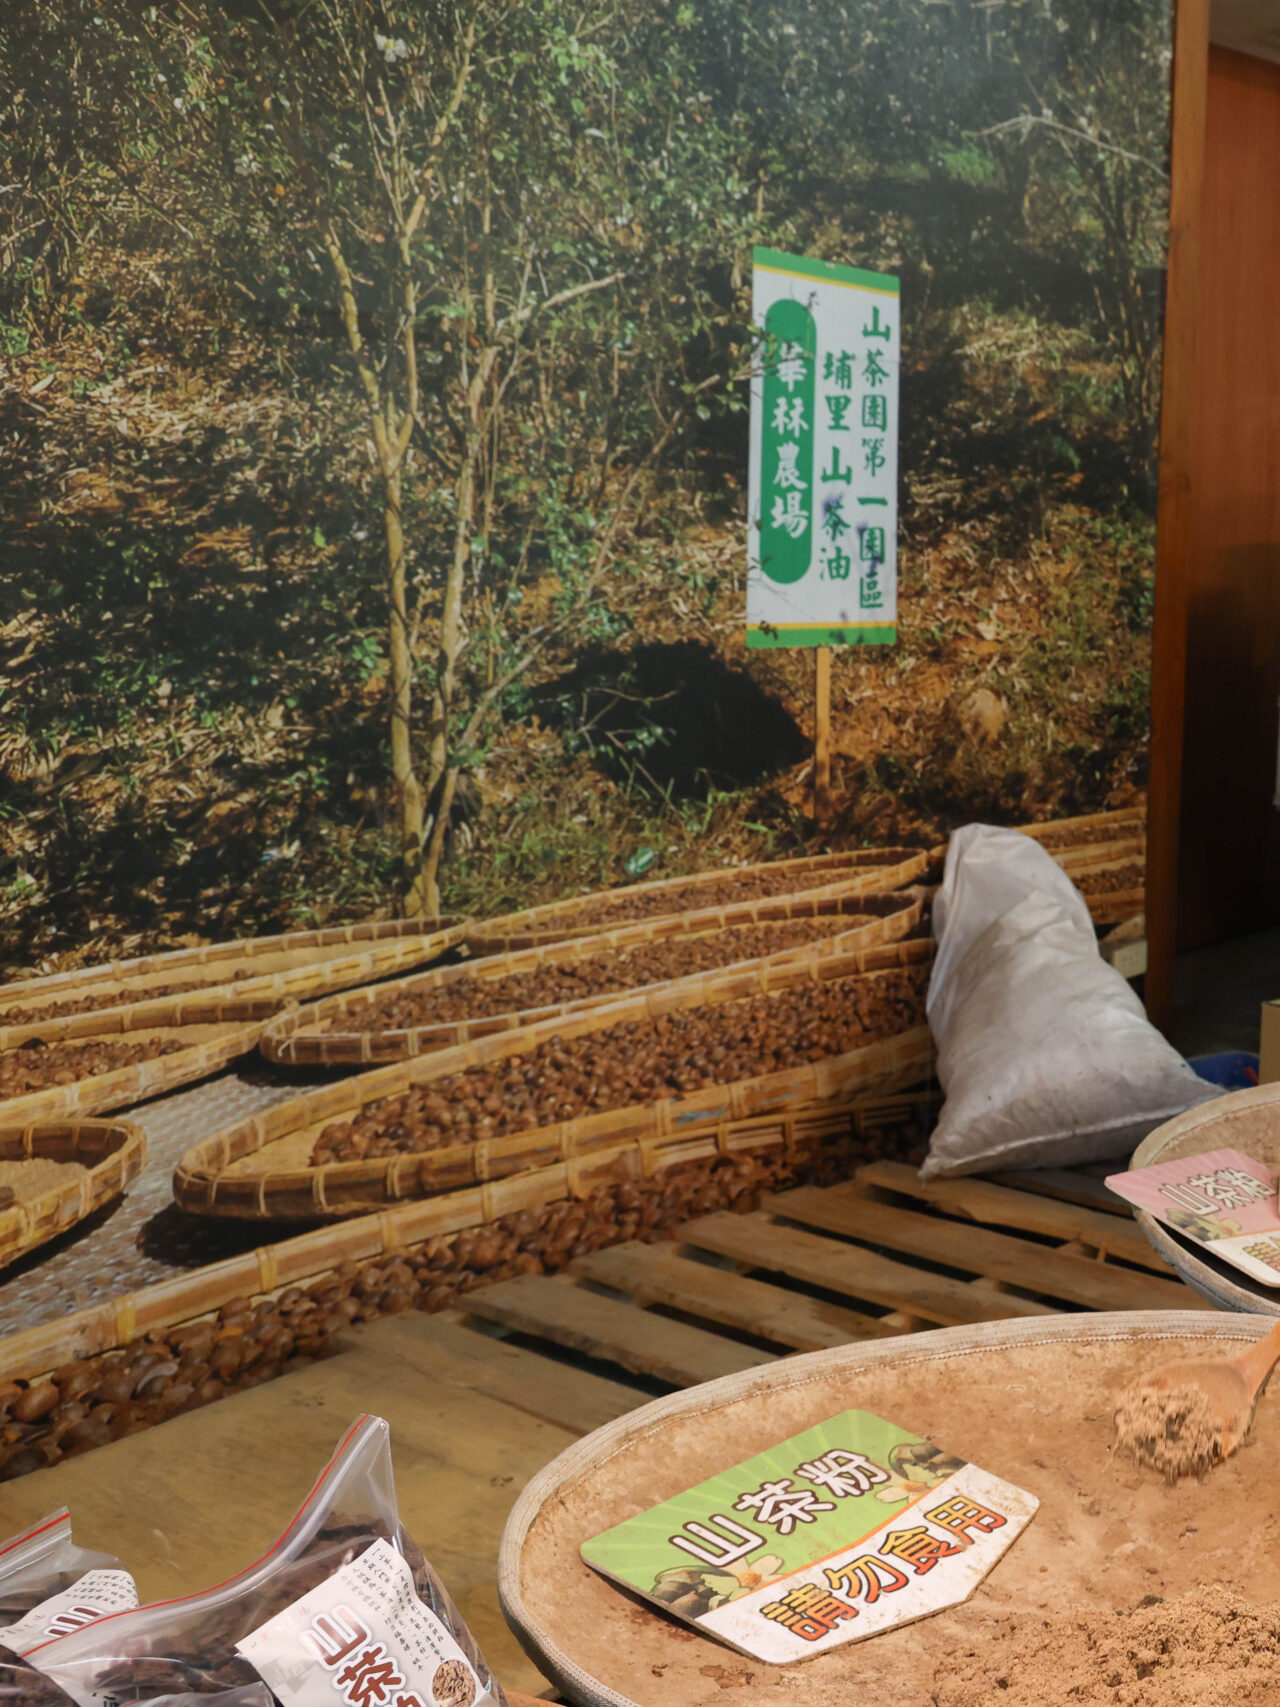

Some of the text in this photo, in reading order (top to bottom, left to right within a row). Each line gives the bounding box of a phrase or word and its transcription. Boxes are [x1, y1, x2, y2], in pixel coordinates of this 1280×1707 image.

[819, 349, 856, 581] 埔里山茶油
[857, 305, 892, 608] 山茶園第一園區
[668, 1447, 893, 1569] 山茶粉
[759, 1494, 1007, 1642] 請勿食用
[302, 1602, 421, 1707] 山茶
